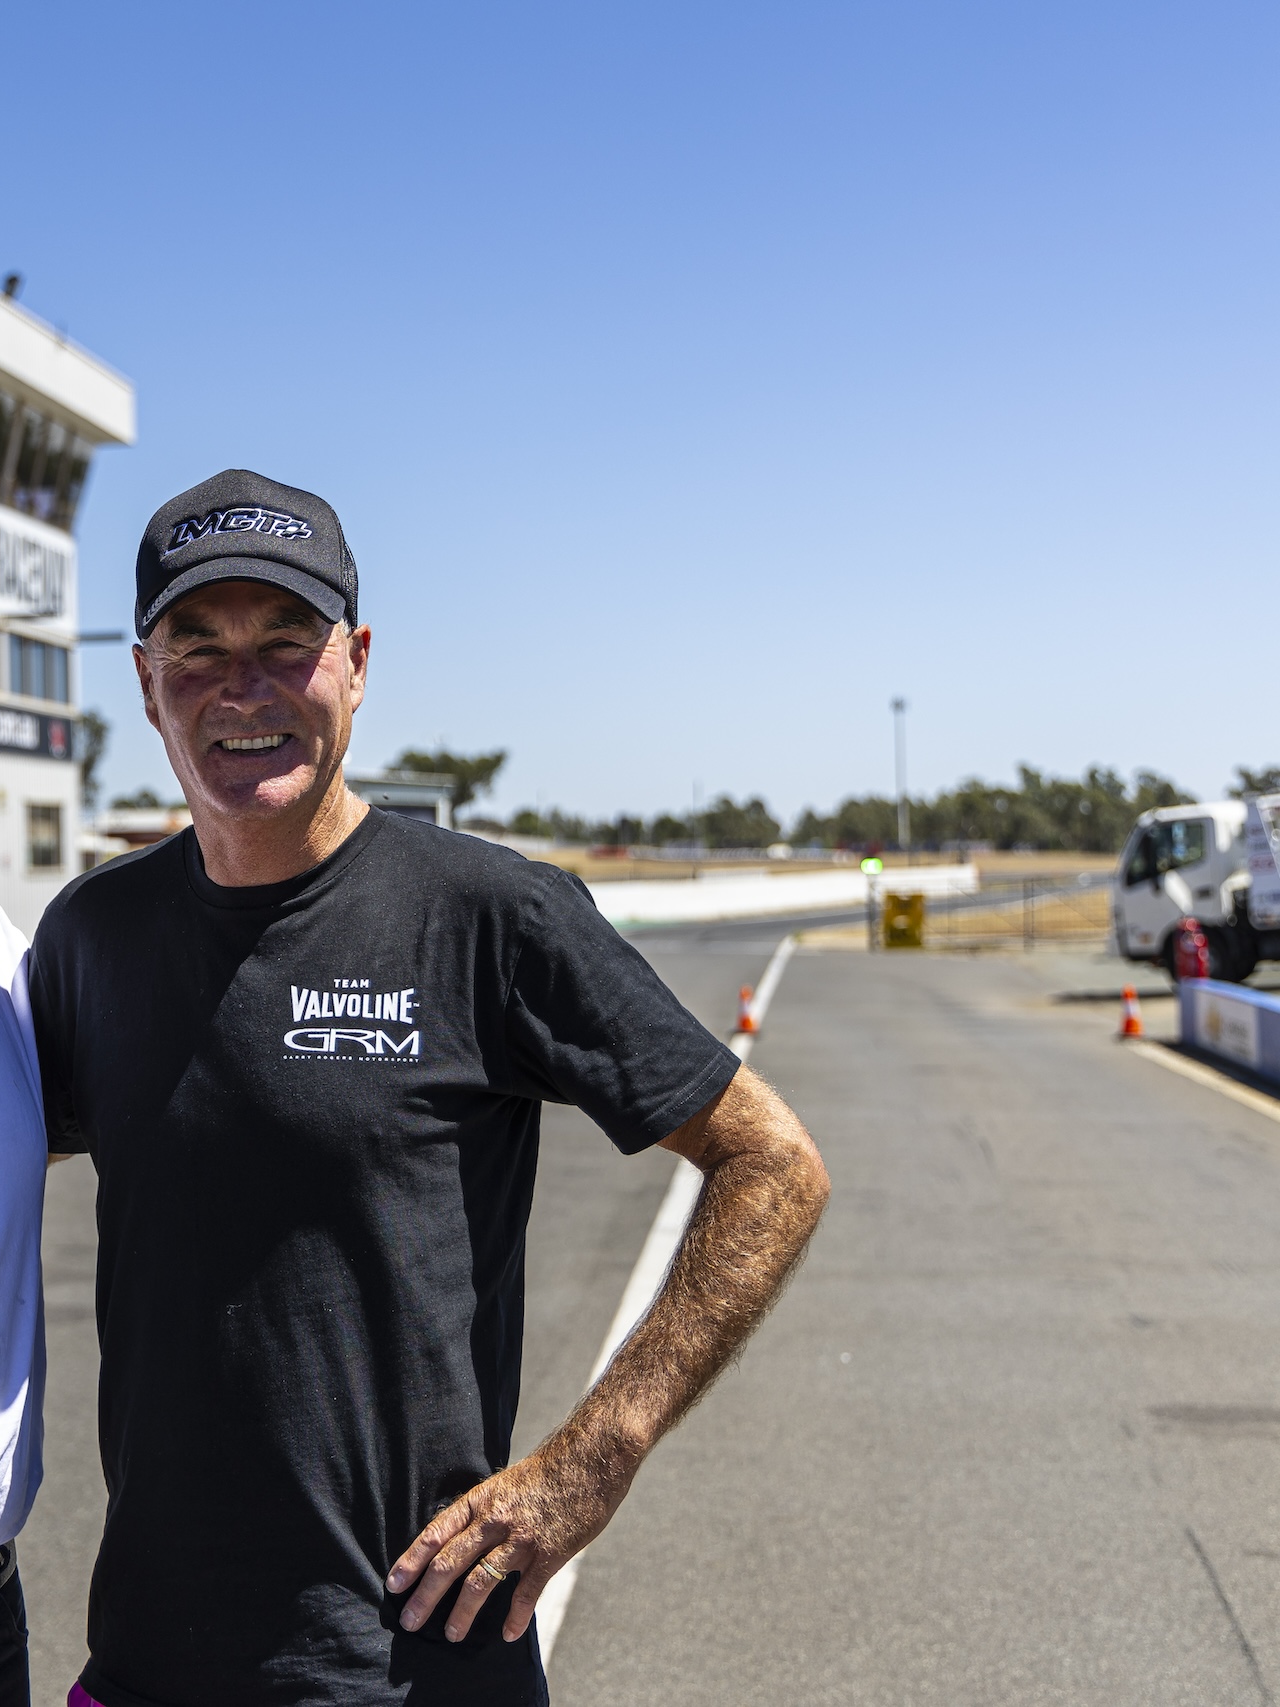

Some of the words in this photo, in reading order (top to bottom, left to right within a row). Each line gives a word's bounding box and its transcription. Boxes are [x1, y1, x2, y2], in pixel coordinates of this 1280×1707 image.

[333, 978, 370, 989] TEAM
[290, 984, 415, 1025] VALVOLINE
[283, 1028, 420, 1055] GRM
